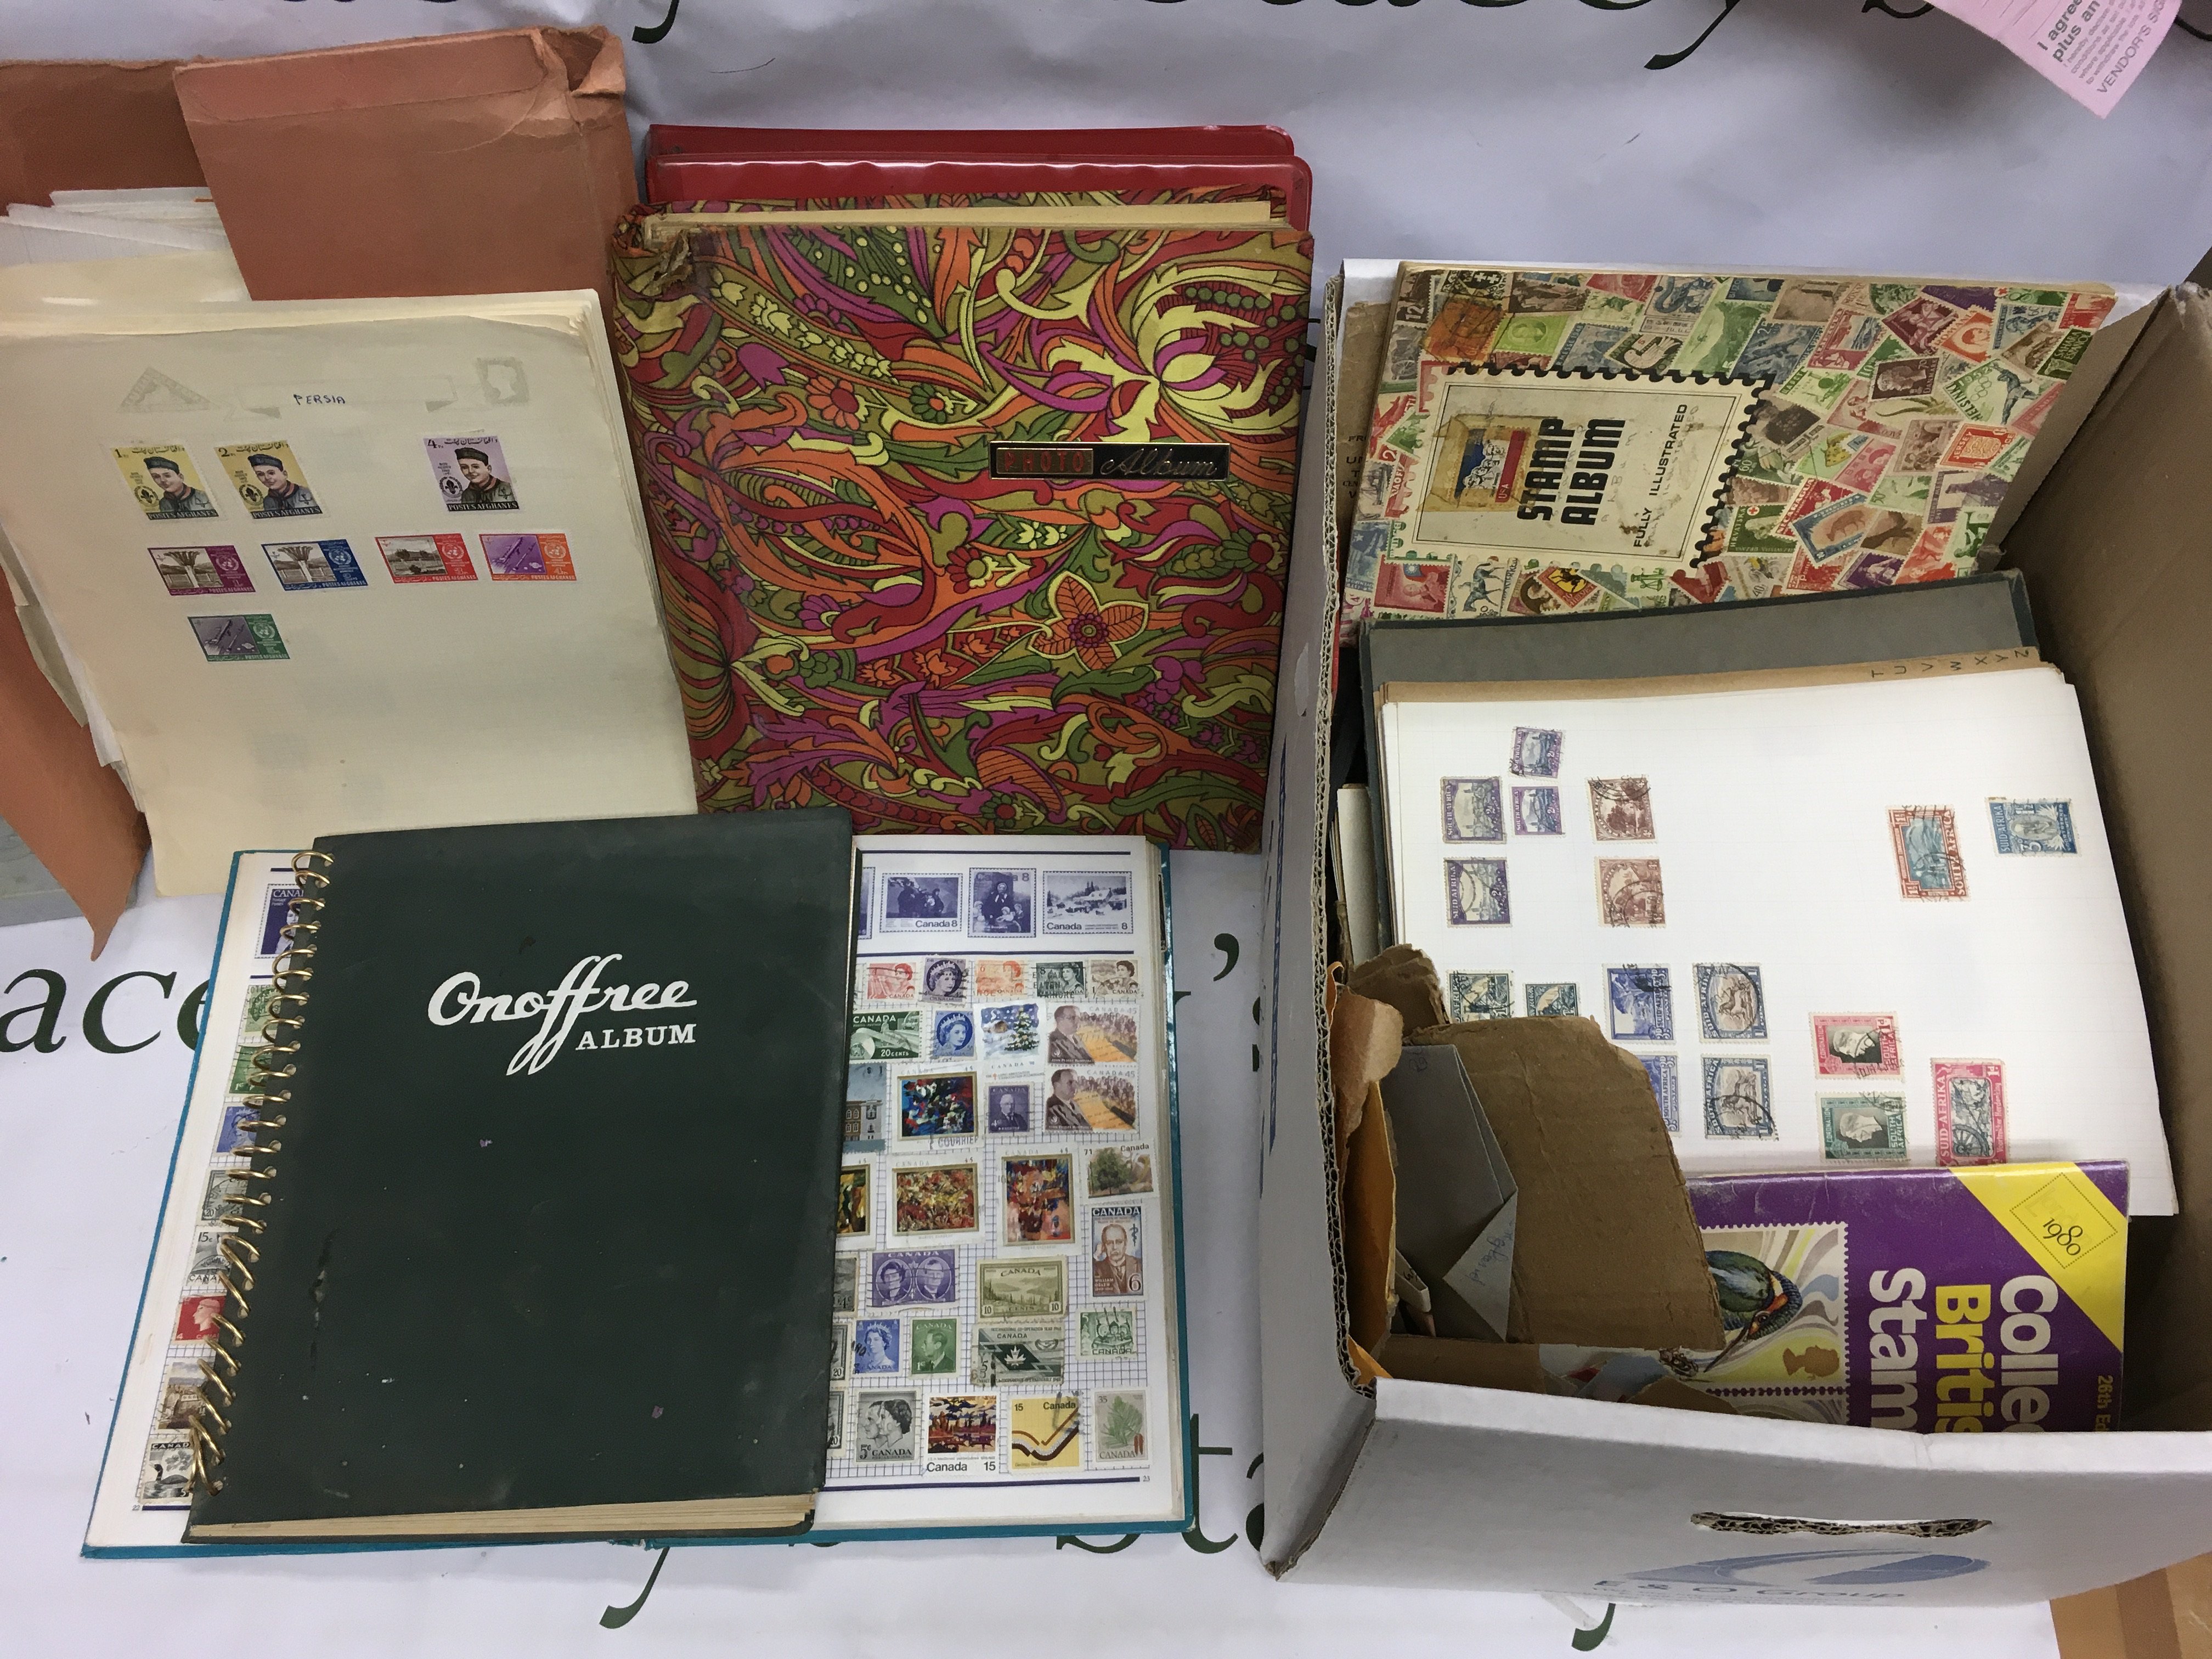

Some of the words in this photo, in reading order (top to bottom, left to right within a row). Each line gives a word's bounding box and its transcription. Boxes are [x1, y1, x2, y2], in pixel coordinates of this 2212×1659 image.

[2052, 25, 2082, 63] plus
[2097, 24, 2152, 94] VENDOR'S
[1934, 311, 1977, 346] ROMANIA
[2054, 331, 2081, 358] SAHARA
[1923, 359, 1938, 393] DANMARK
[294, 394, 346, 405] PERSIA
[1945, 384, 1983, 422] HELSINKI
[1004, 451, 1084, 472] PHOTO
[1099, 448, 1218, 476] Album
[1954, 432, 1972, 459] JERSEY
[1516, 418, 1576, 521] STAMP
[1561, 419, 1626, 525] ALBUM
[1634, 507, 1653, 548] FULLY
[1649, 404, 1688, 496] ILLUSTRATED
[1498, 483, 1509, 500] USA
[1776, 478, 1815, 533] NICARAGUA
[1730, 507, 1746, 548] HRVATSKA
[1974, 656, 1987, 665] X
[1943, 810, 1958, 851] AFRICA
[428, 953, 697, 1075] Onoffree
[853, 1015, 896, 1023] CANADA
[575, 1024, 697, 1050] ALBUM
[881, 1049, 890, 1057] 20
[1818, 1025, 1826, 1059] CORONATION
[1706, 1059, 1719, 1096] AFRICA
[1824, 1108, 1832, 1142] CORONATION
[1888, 1116, 1898, 1148] SOUTH
[1895, 1115, 1905, 1148] AFRICA
[1936, 1075, 1949, 1158] SUID-AFRIKA
[1120, 1143, 1149, 1152] Canada
[1092, 1207, 1141, 1216] CANADA
[2042, 1218, 2084, 1256] 1980
[1001, 1268, 1041, 1277] CANADA
[1128, 1274, 1141, 1292] 6
[984, 1306, 992, 1314] 10
[1869, 1267, 1927, 1433] Stam
[833, 1368, 841, 1376] 20
[1043, 1401, 1076, 1410] Canada
[2097, 1375, 2114, 1408] 26th
[927, 1462, 967, 1472] Canada
[984, 1462, 996, 1471] 15
[1099, 1451, 1135, 1459] CANADA
